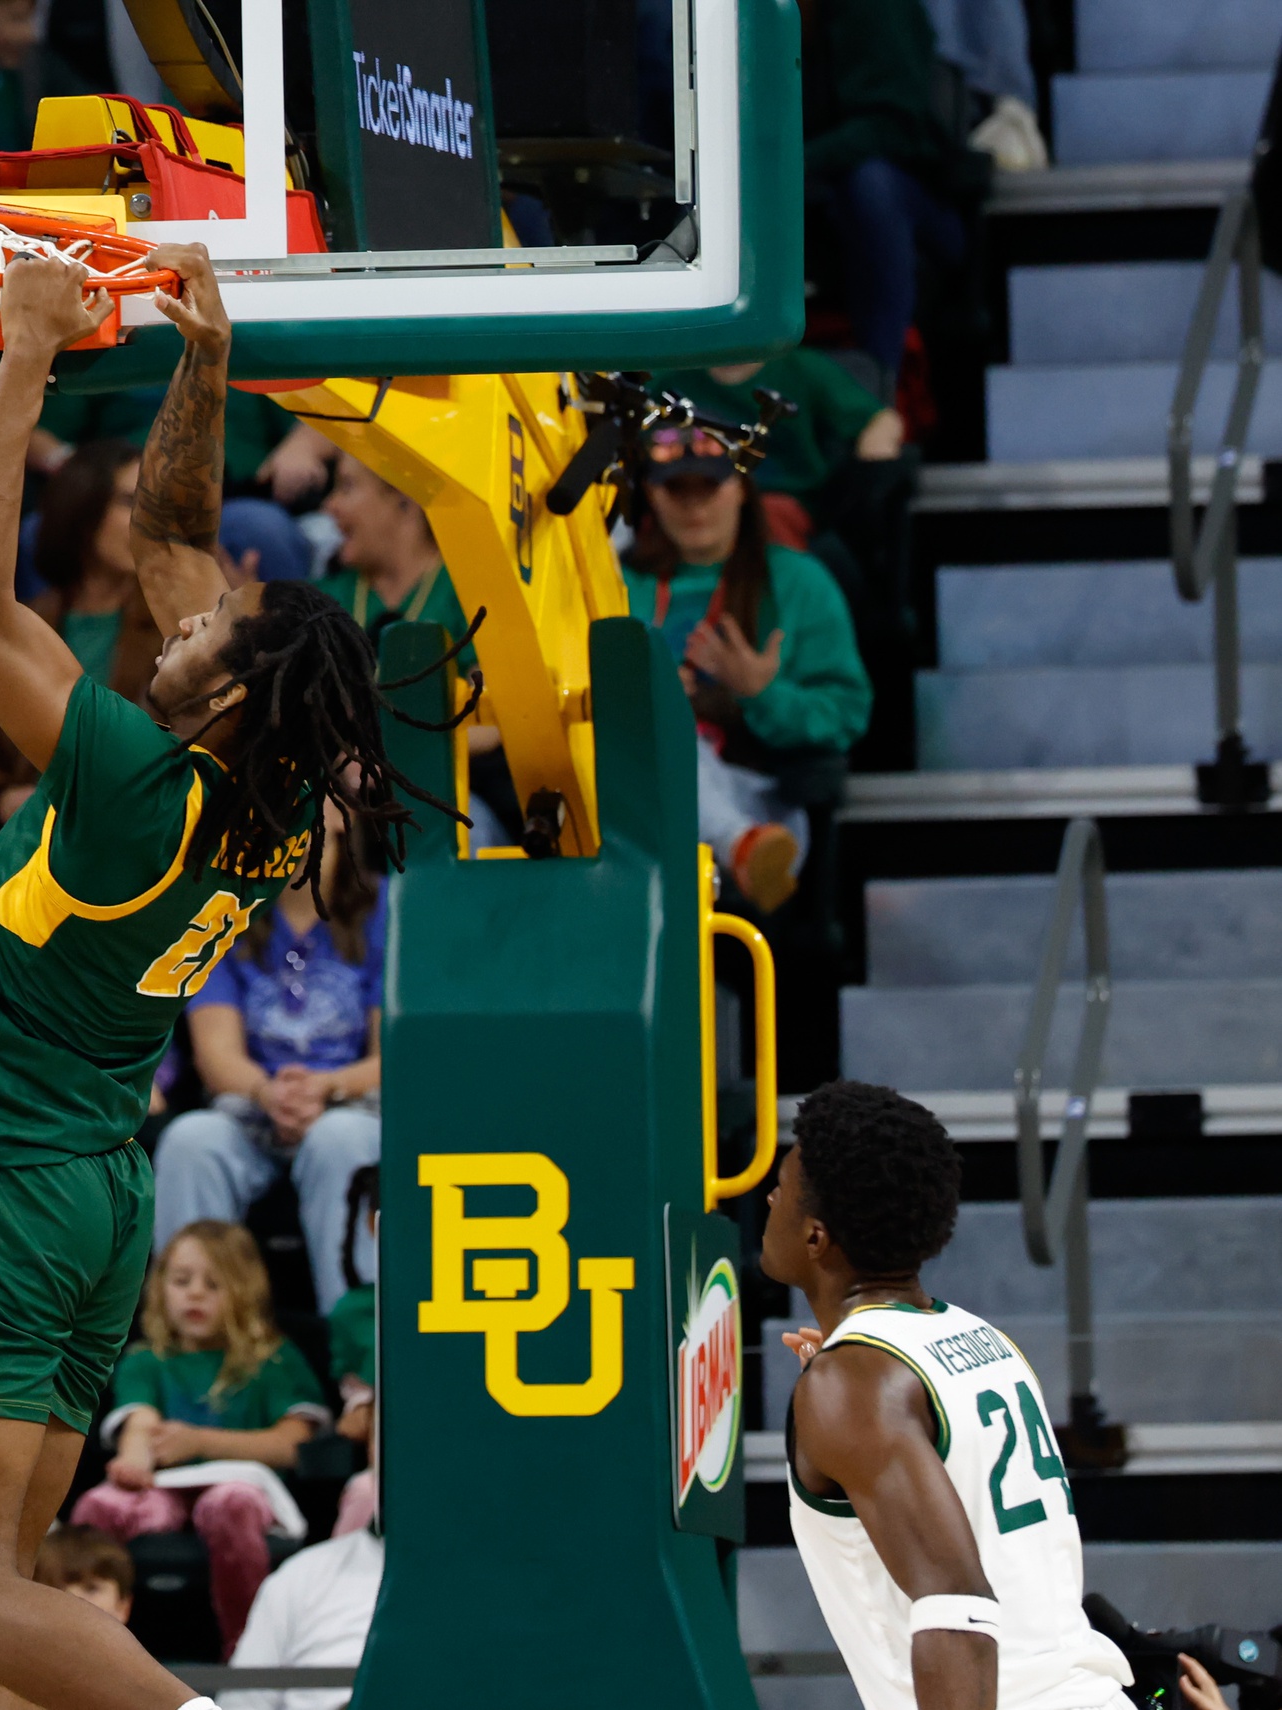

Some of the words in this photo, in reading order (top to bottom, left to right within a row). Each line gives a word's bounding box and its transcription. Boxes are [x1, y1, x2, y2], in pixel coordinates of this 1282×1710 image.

[353, 51, 474, 159] TicketSmarter
[418, 1152, 634, 1416] BU
[678, 1299, 739, 1500] LIBMAN
[977, 1381, 1076, 1535] 24
